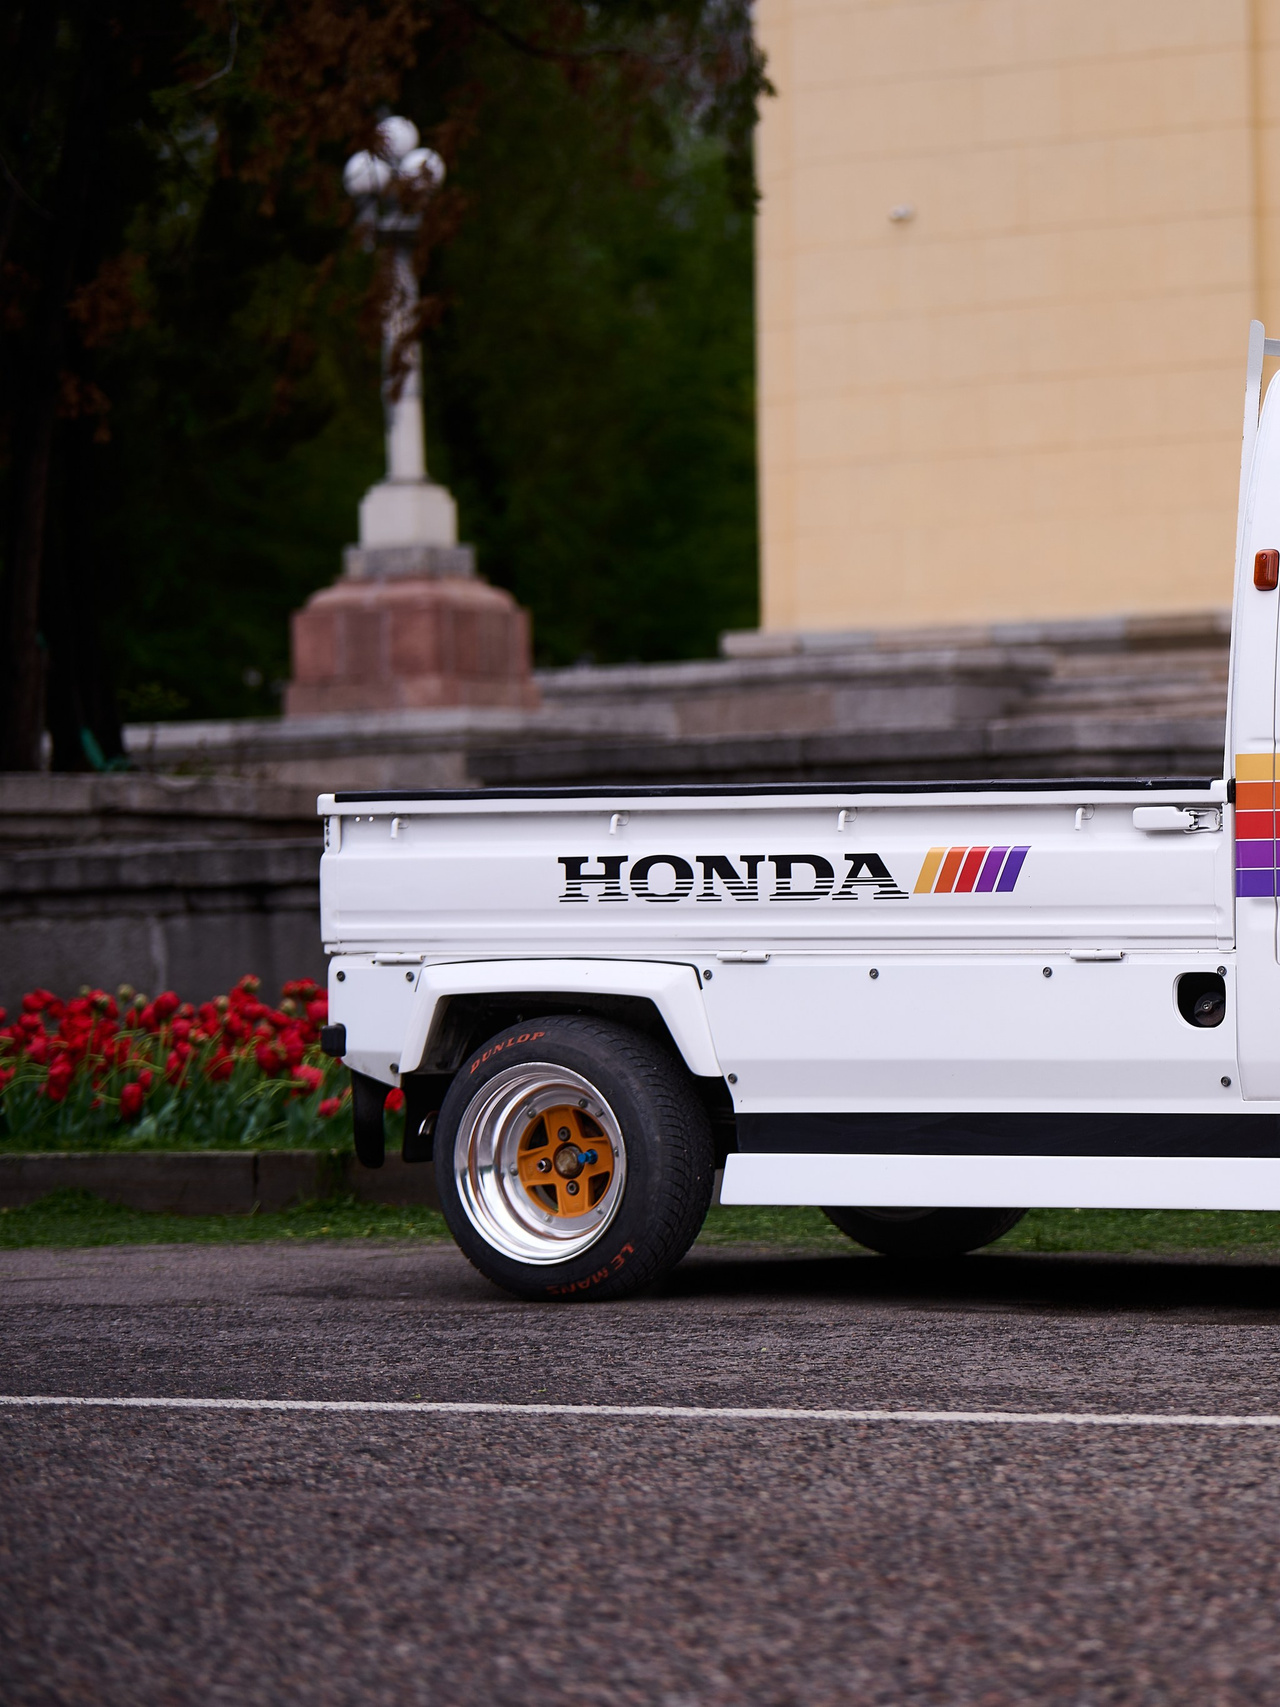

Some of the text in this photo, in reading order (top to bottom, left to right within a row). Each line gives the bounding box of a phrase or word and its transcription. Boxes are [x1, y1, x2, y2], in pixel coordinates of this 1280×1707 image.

[557, 852, 910, 903] HONDA
[470, 1031, 546, 1075] DUNLOP
[545, 1242, 634, 1295] LE MANS
